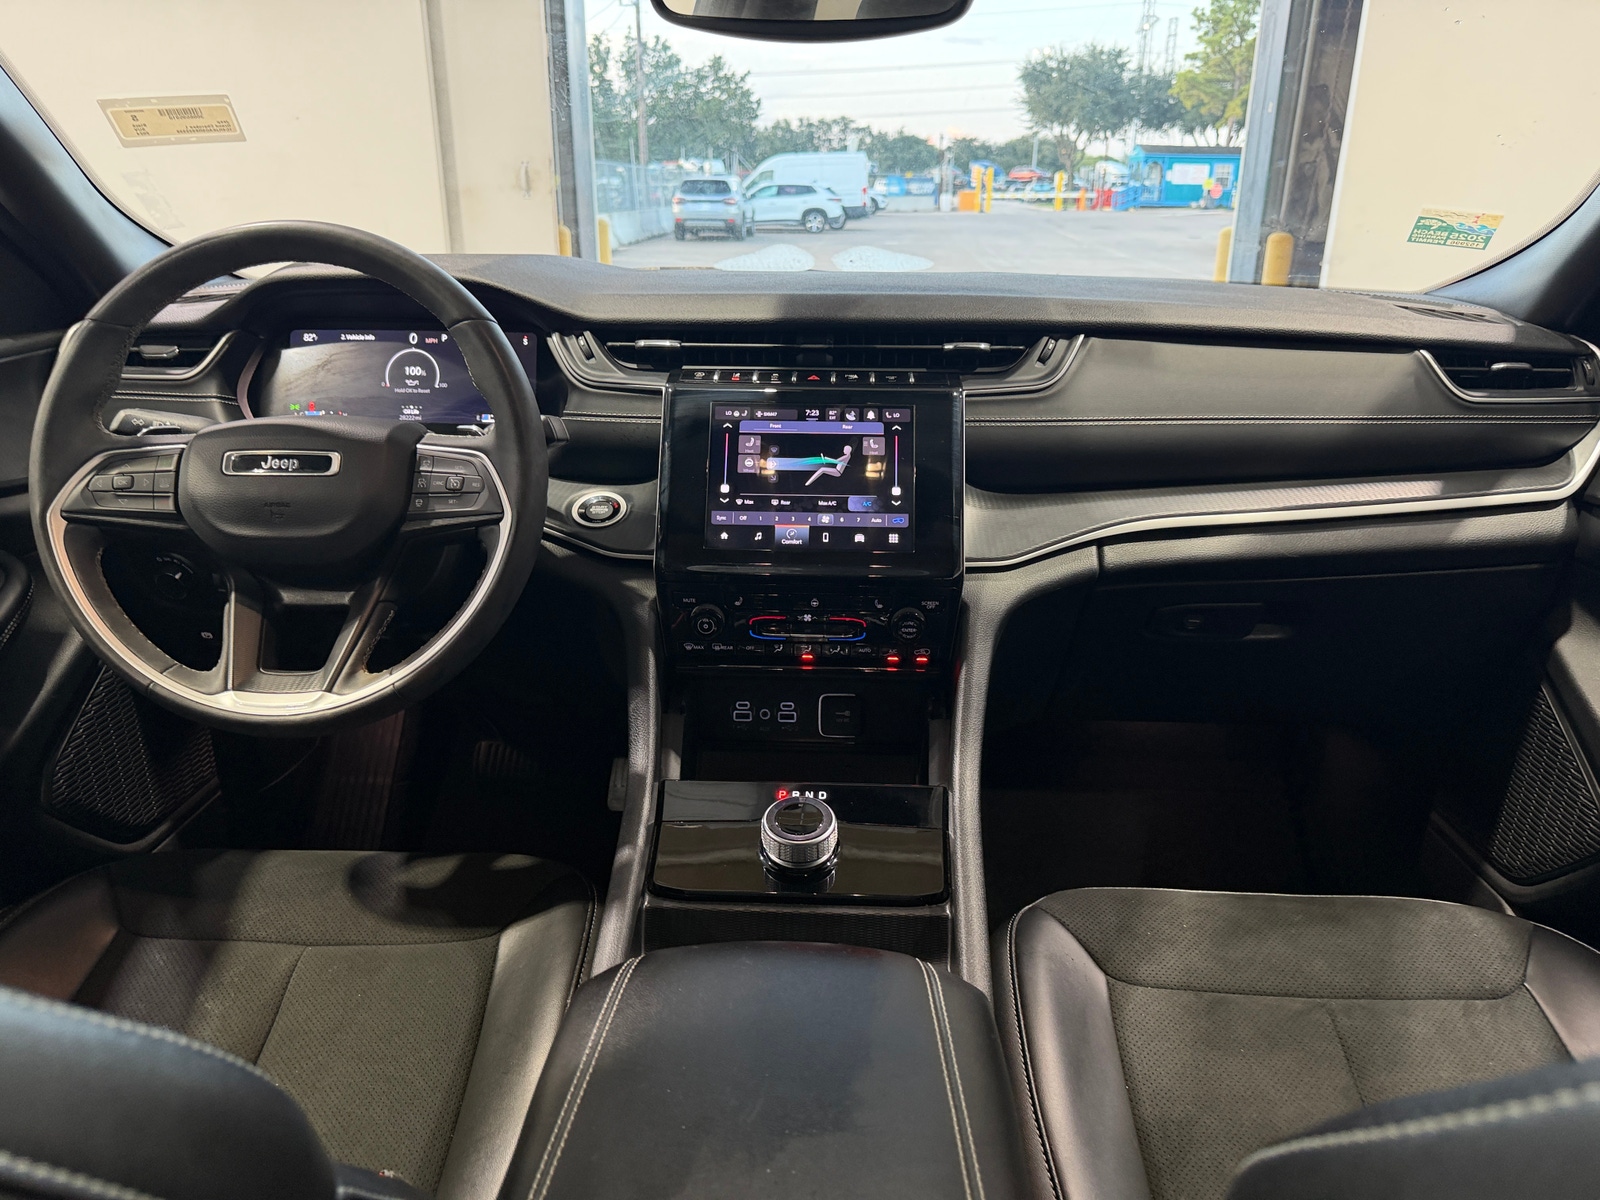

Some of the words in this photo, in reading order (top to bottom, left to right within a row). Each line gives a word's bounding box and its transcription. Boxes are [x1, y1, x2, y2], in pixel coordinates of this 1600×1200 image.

[408, 332, 418, 344] 0
[441, 334, 448, 342] P
[261, 456, 298, 471] Jeep
